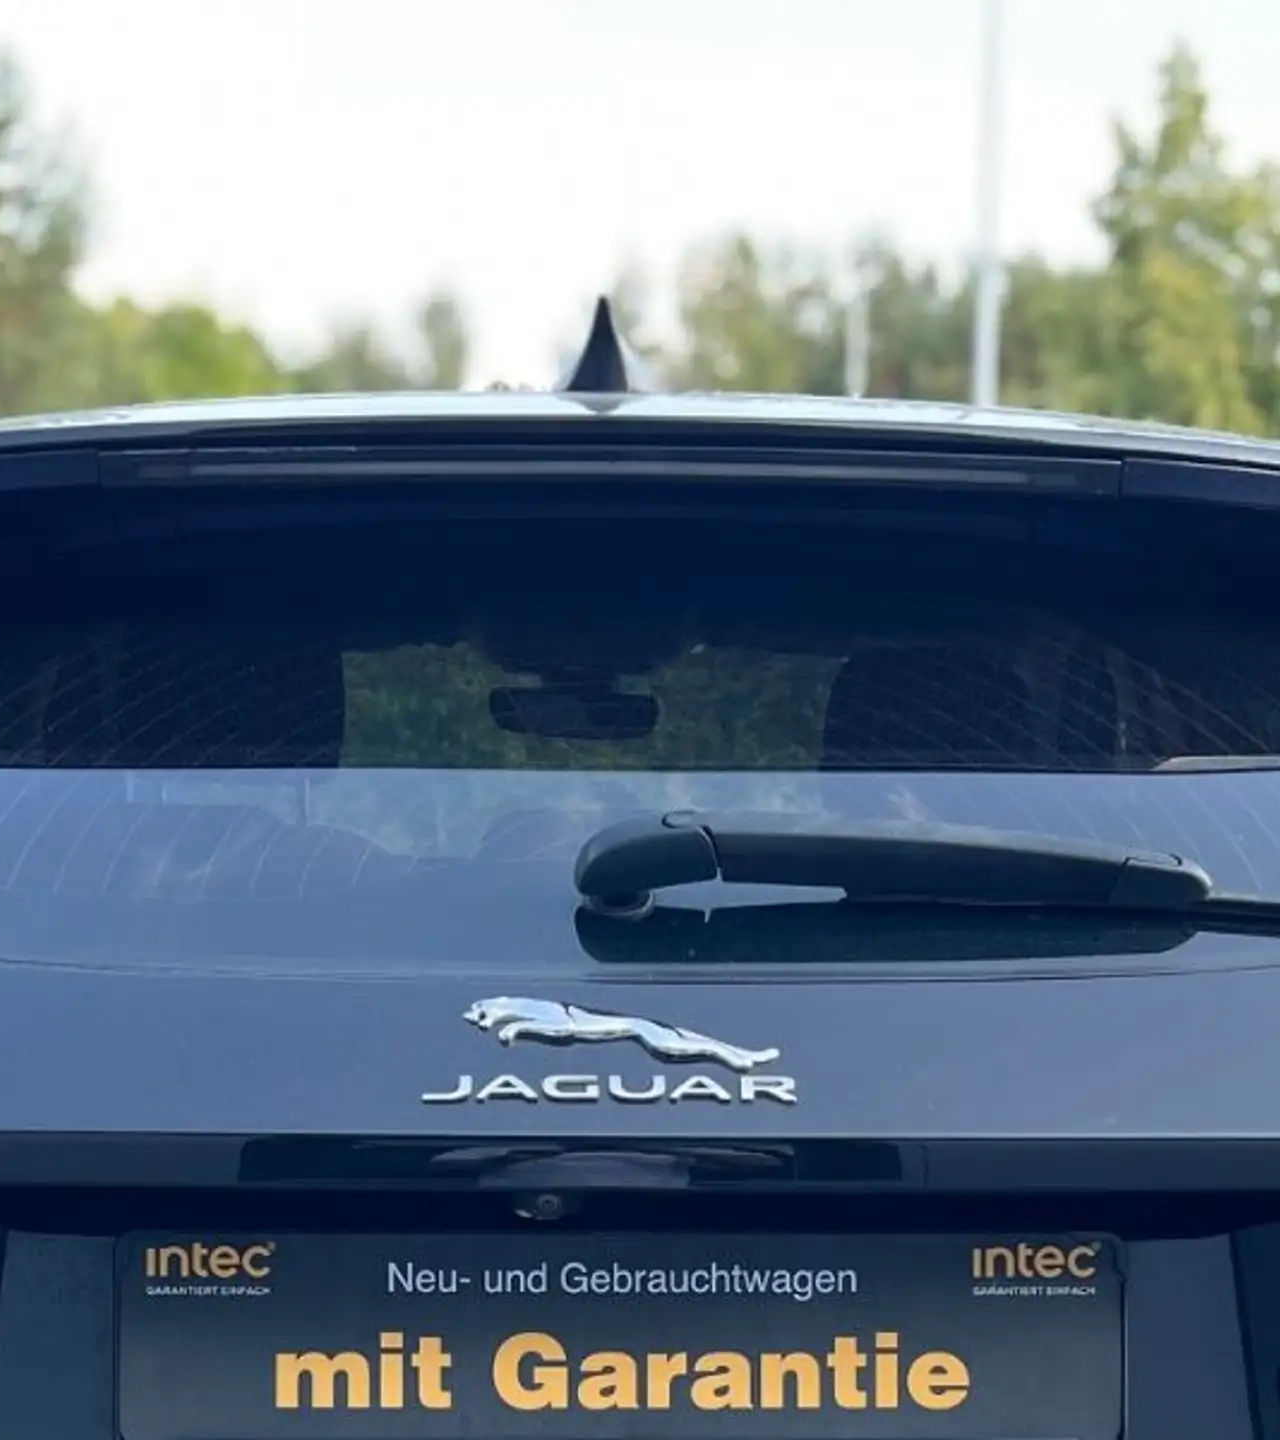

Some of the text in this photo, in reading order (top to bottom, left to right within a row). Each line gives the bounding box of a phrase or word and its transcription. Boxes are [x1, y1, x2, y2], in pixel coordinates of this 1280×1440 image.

[421, 1074, 798, 1104] JAGUAR
[145, 1242, 271, 1278] intec
[972, 1242, 1096, 1278] intec
[387, 1262, 858, 1301] Neu- und Gebrauchtwagen
[275, 1331, 971, 1411] mit Garantie
